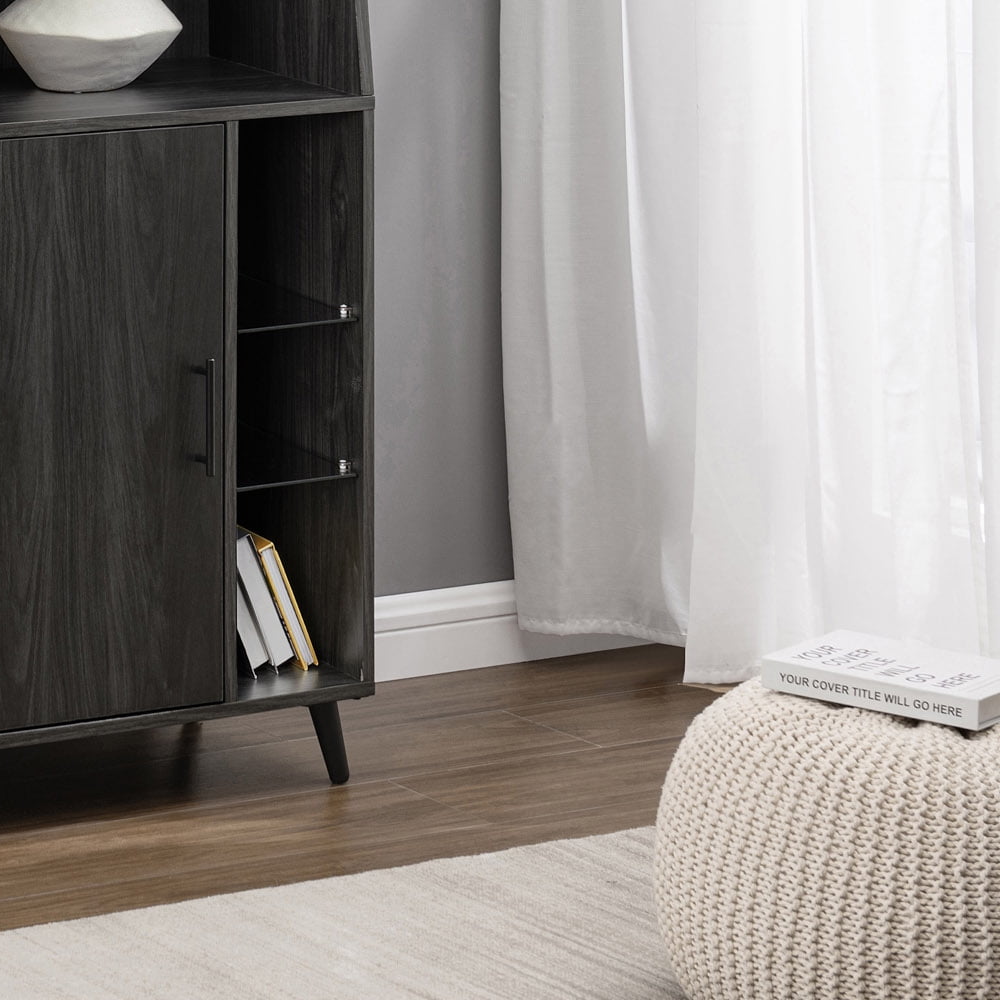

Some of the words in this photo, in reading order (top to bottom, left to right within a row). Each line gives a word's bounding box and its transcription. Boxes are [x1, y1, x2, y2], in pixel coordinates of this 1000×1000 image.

[792, 645, 841, 660] YOUR
[821, 649, 878, 666] COVER
[848, 657, 897, 671] TITLE
[874, 664, 920, 678] WILL
[906, 673, 936, 683] GO
[931, 673, 982, 689] HERE
[779, 672, 810, 687] YOUR
[811, 680, 849, 695] COVER
[852, 687, 882, 701] TITLE
[884, 693, 910, 707] WILL
[913, 700, 930, 711] GO
[932, 704, 963, 718] HERE
